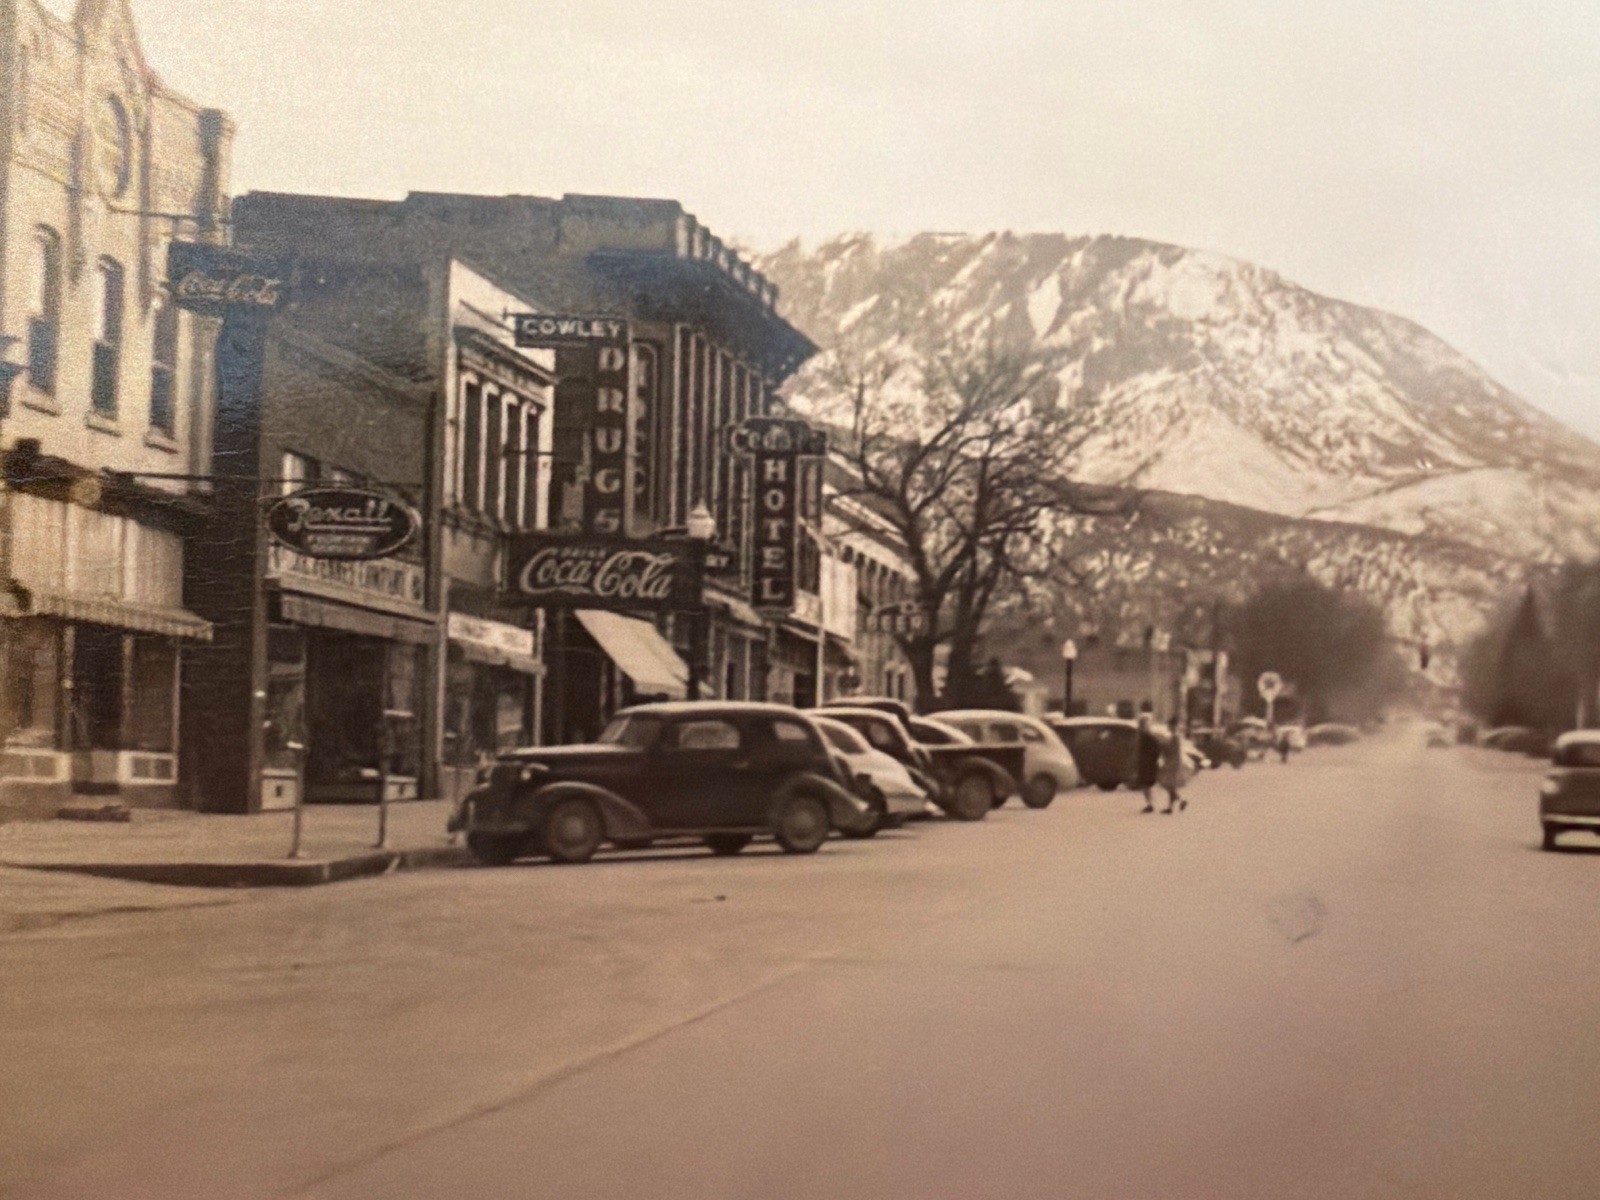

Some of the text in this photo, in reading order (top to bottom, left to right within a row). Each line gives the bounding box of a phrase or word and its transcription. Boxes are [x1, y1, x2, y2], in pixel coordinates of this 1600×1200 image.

[521, 318, 622, 338] COWLEY
[594, 347, 625, 533] DRUGS
[286, 498, 393, 532] Rexall
[761, 458, 788, 600] HOTEL
